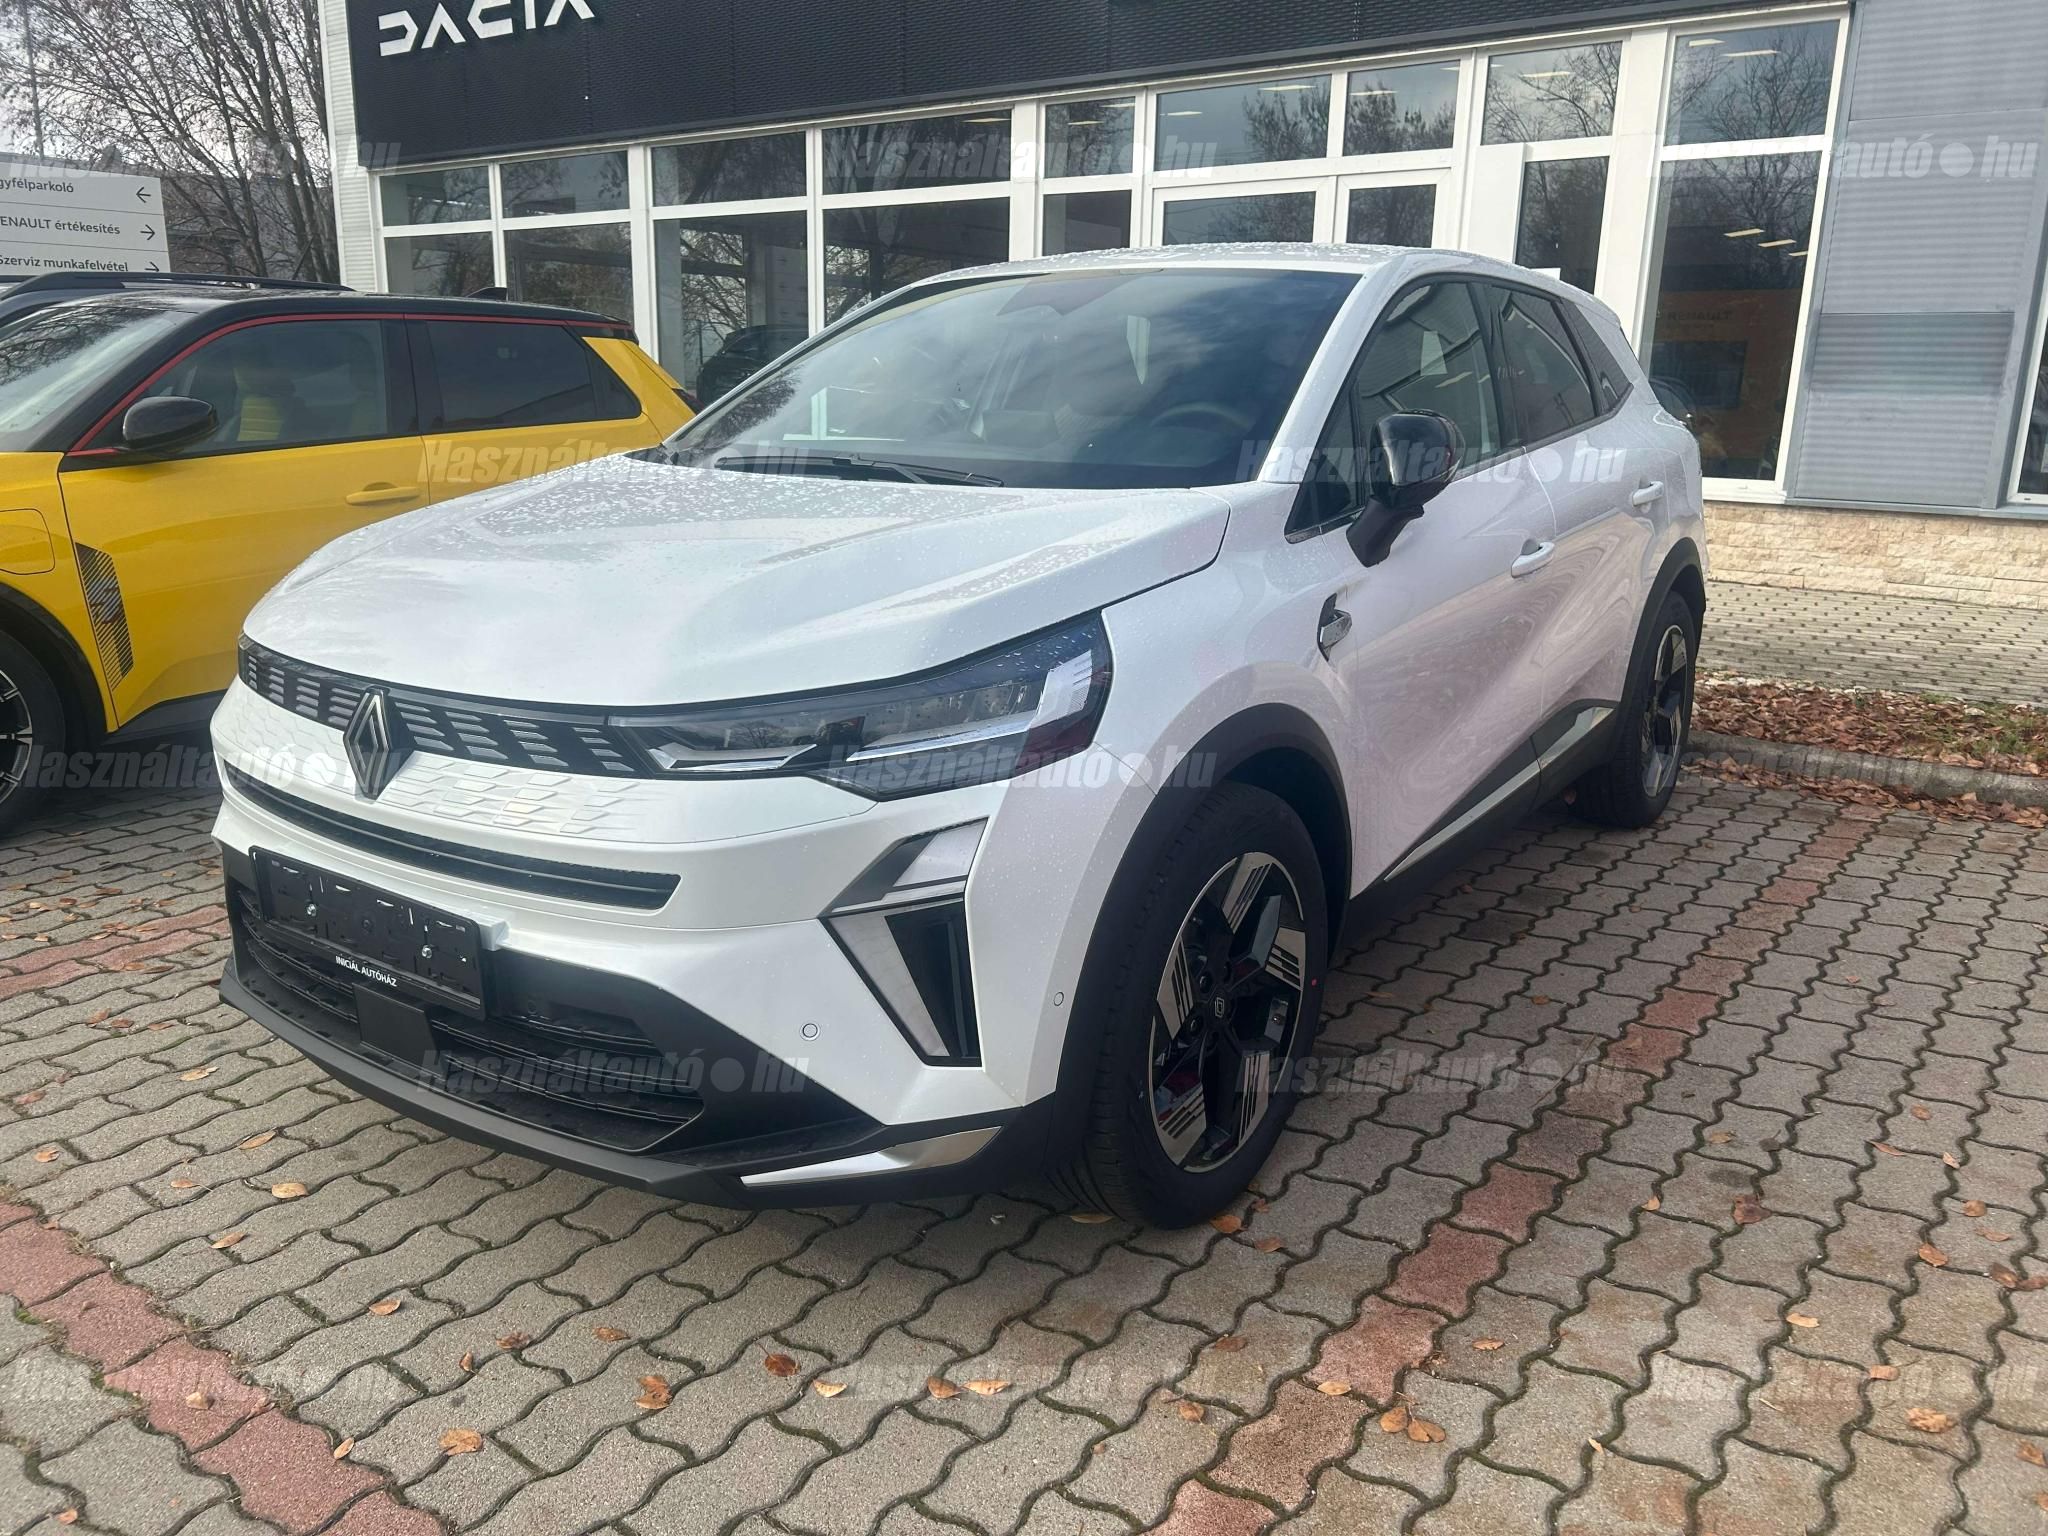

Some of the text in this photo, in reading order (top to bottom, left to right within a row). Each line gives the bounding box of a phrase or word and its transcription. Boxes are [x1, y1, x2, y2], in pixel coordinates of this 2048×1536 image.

[0, 215, 120, 235] ENAULT értékesítés
[43, 257, 129, 272] munkafelvétel
[335, 956, 397, 987] INICIÁL AUTÓHÁZ
